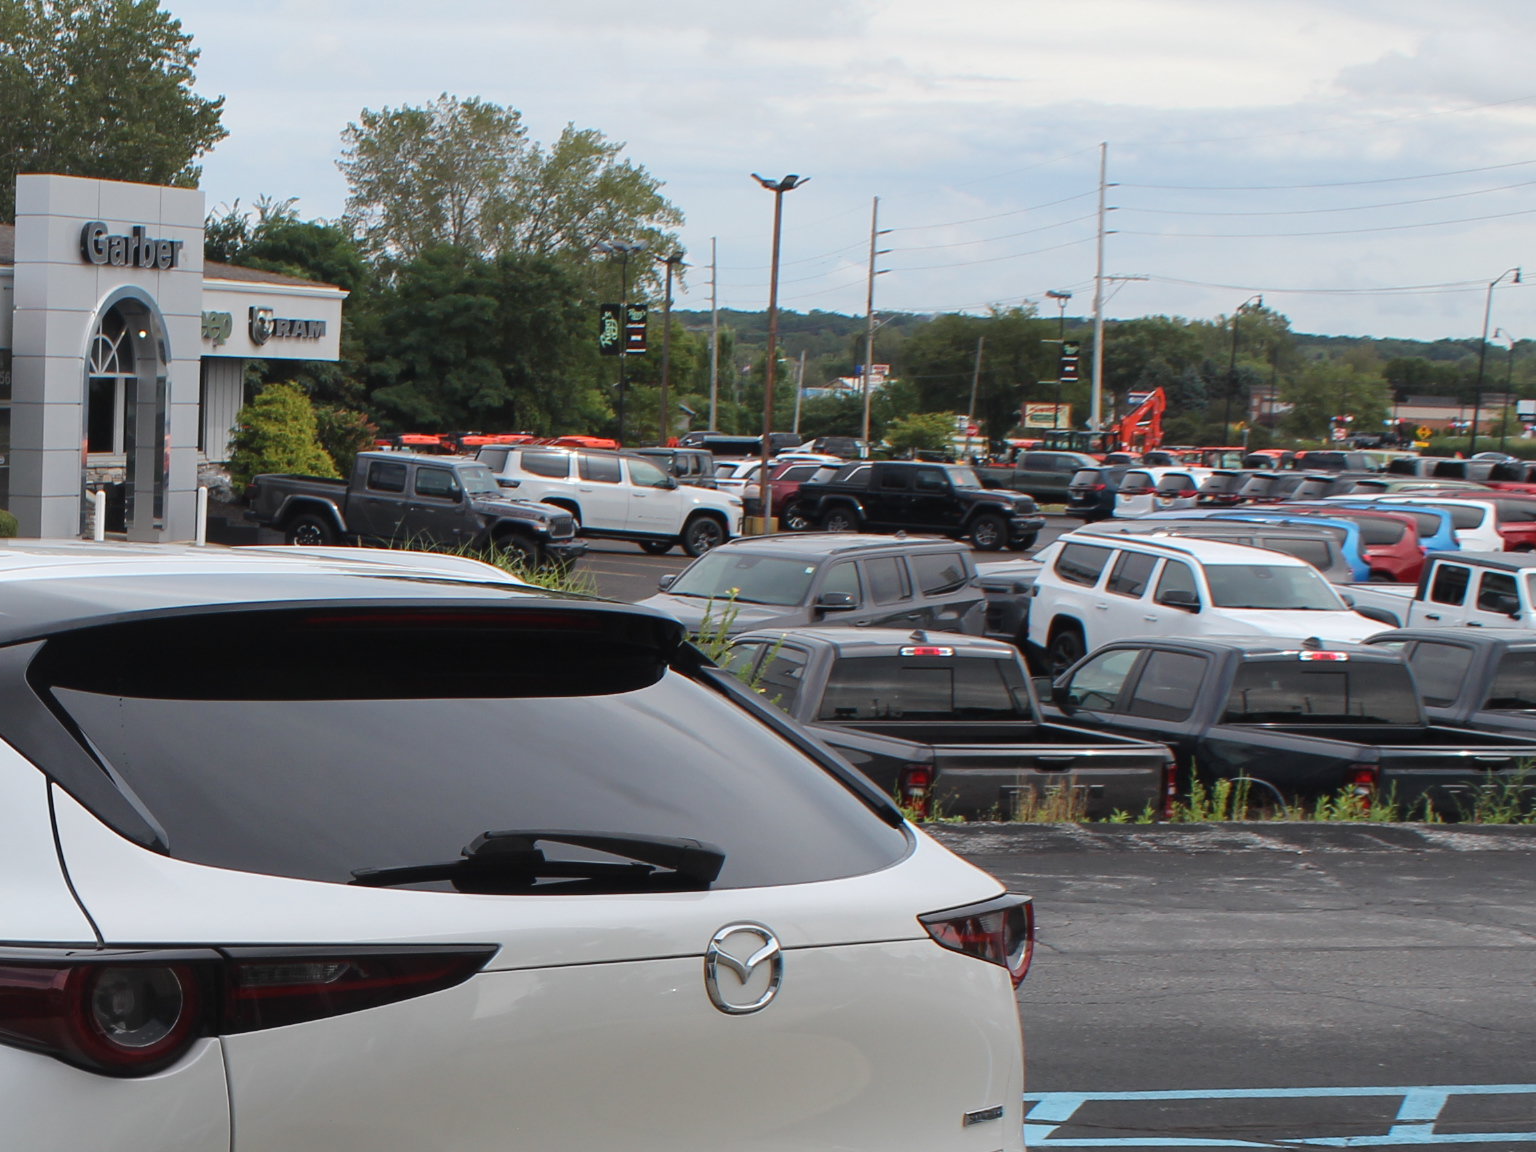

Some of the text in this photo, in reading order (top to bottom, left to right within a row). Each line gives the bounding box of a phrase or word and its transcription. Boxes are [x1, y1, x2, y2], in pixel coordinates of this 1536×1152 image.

[81, 221, 184, 270] Garber
[201, 311, 233, 346] eep
[272, 317, 327, 339] RAM
